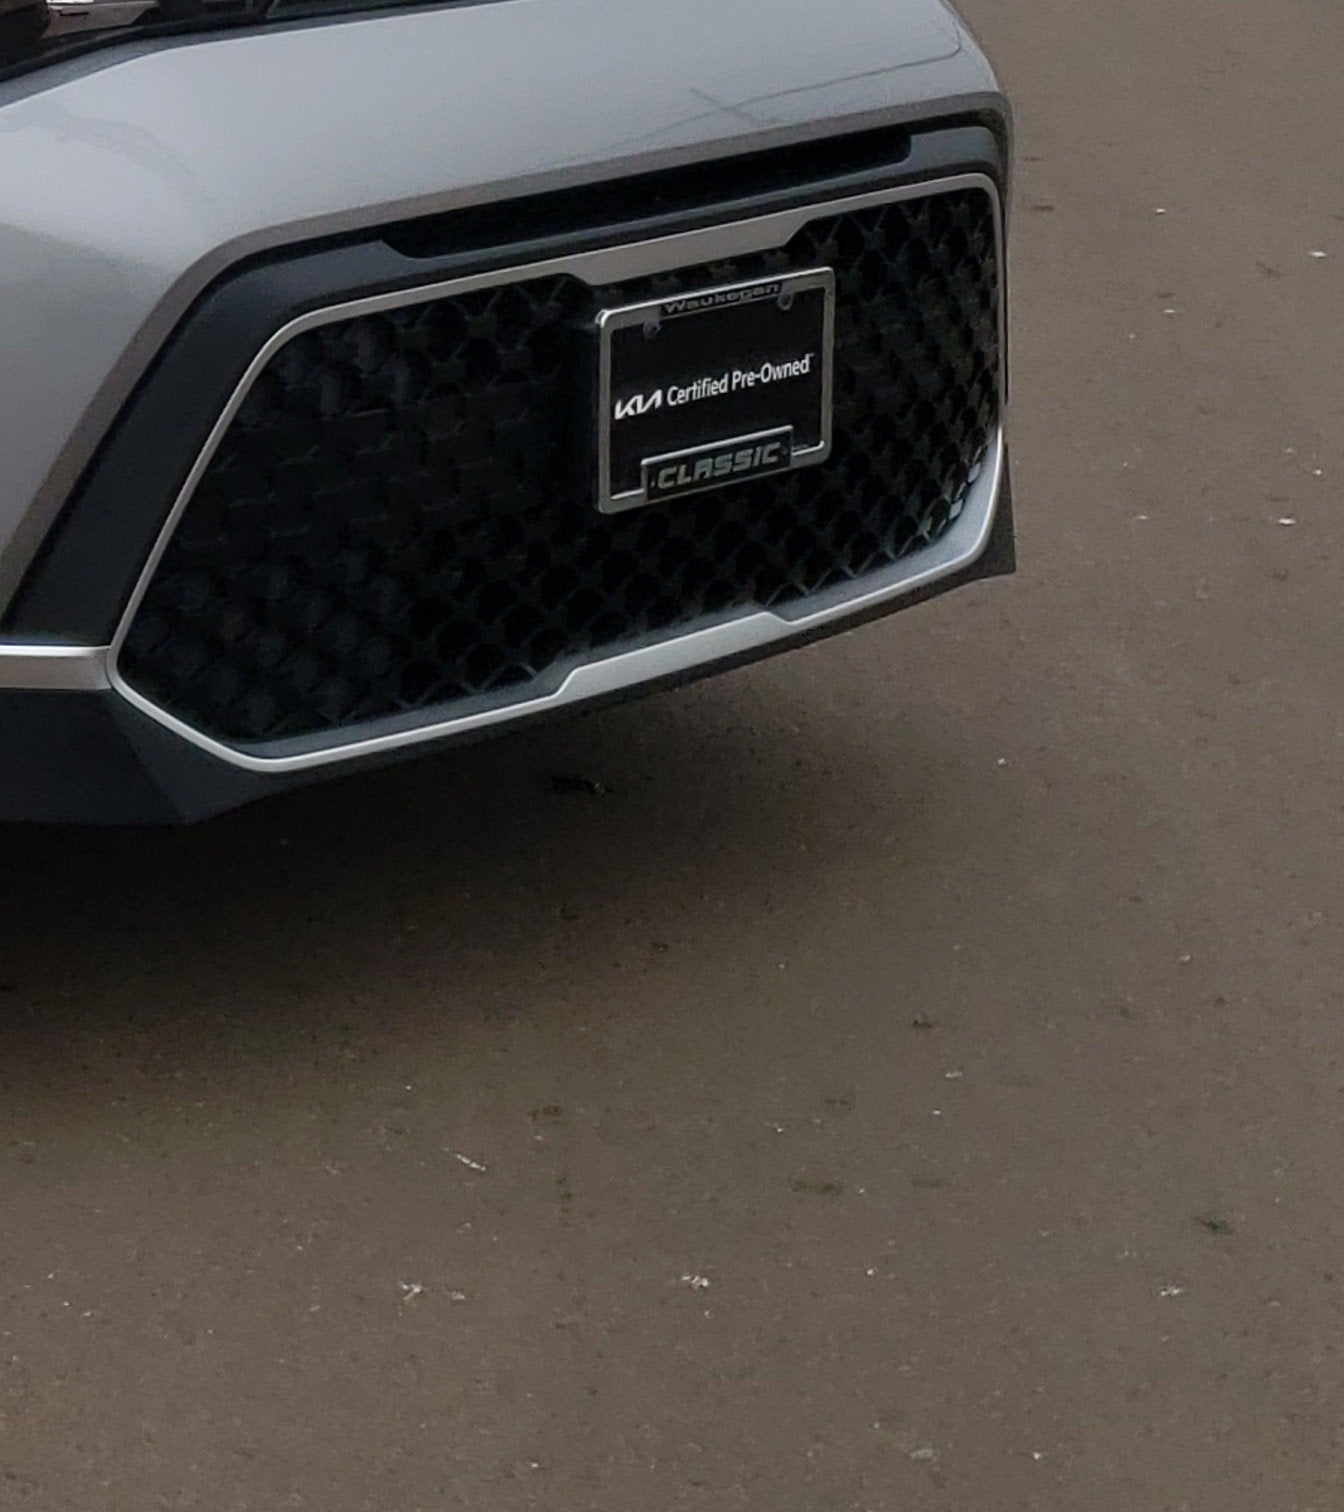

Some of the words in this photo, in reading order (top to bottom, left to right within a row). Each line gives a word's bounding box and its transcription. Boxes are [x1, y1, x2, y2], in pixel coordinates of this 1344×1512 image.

[614, 389, 662, 420] KIA
[666, 374, 728, 406] Certified
[731, 355, 811, 391] Pre-Owned
[657, 441, 781, 489] CLASSIC
